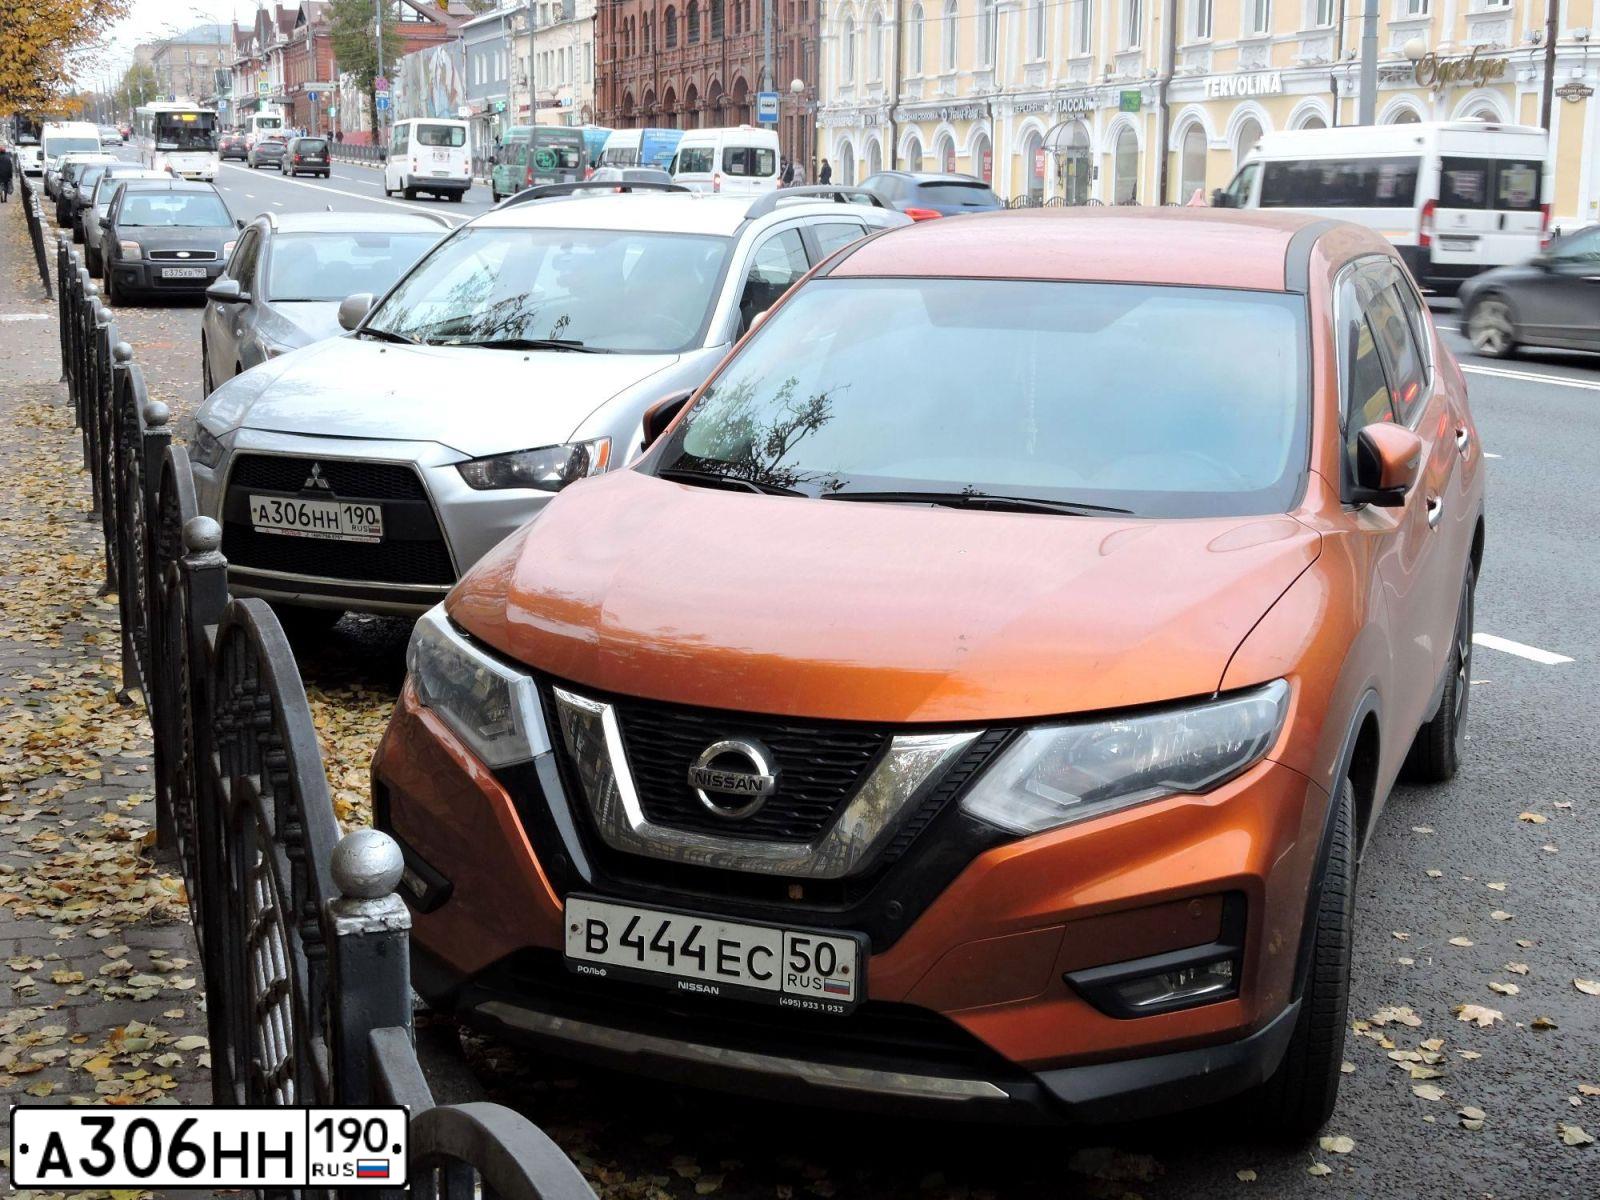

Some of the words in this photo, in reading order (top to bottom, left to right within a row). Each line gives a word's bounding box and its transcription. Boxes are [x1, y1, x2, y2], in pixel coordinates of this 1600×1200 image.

[1203, 74, 1282, 97] TERVOLINA
[343, 505, 376, 525] 190
[351, 524, 368, 533] RUS
[694, 771, 763, 792] NISSAN
[789, 937, 837, 977] 50
[677, 980, 720, 995] NISSAN
[787, 973, 822, 990] RUS
[779, 996, 801, 1008] (495)
[802, 1001, 819, 1010] 933
[827, 1004, 844, 1013] 933
